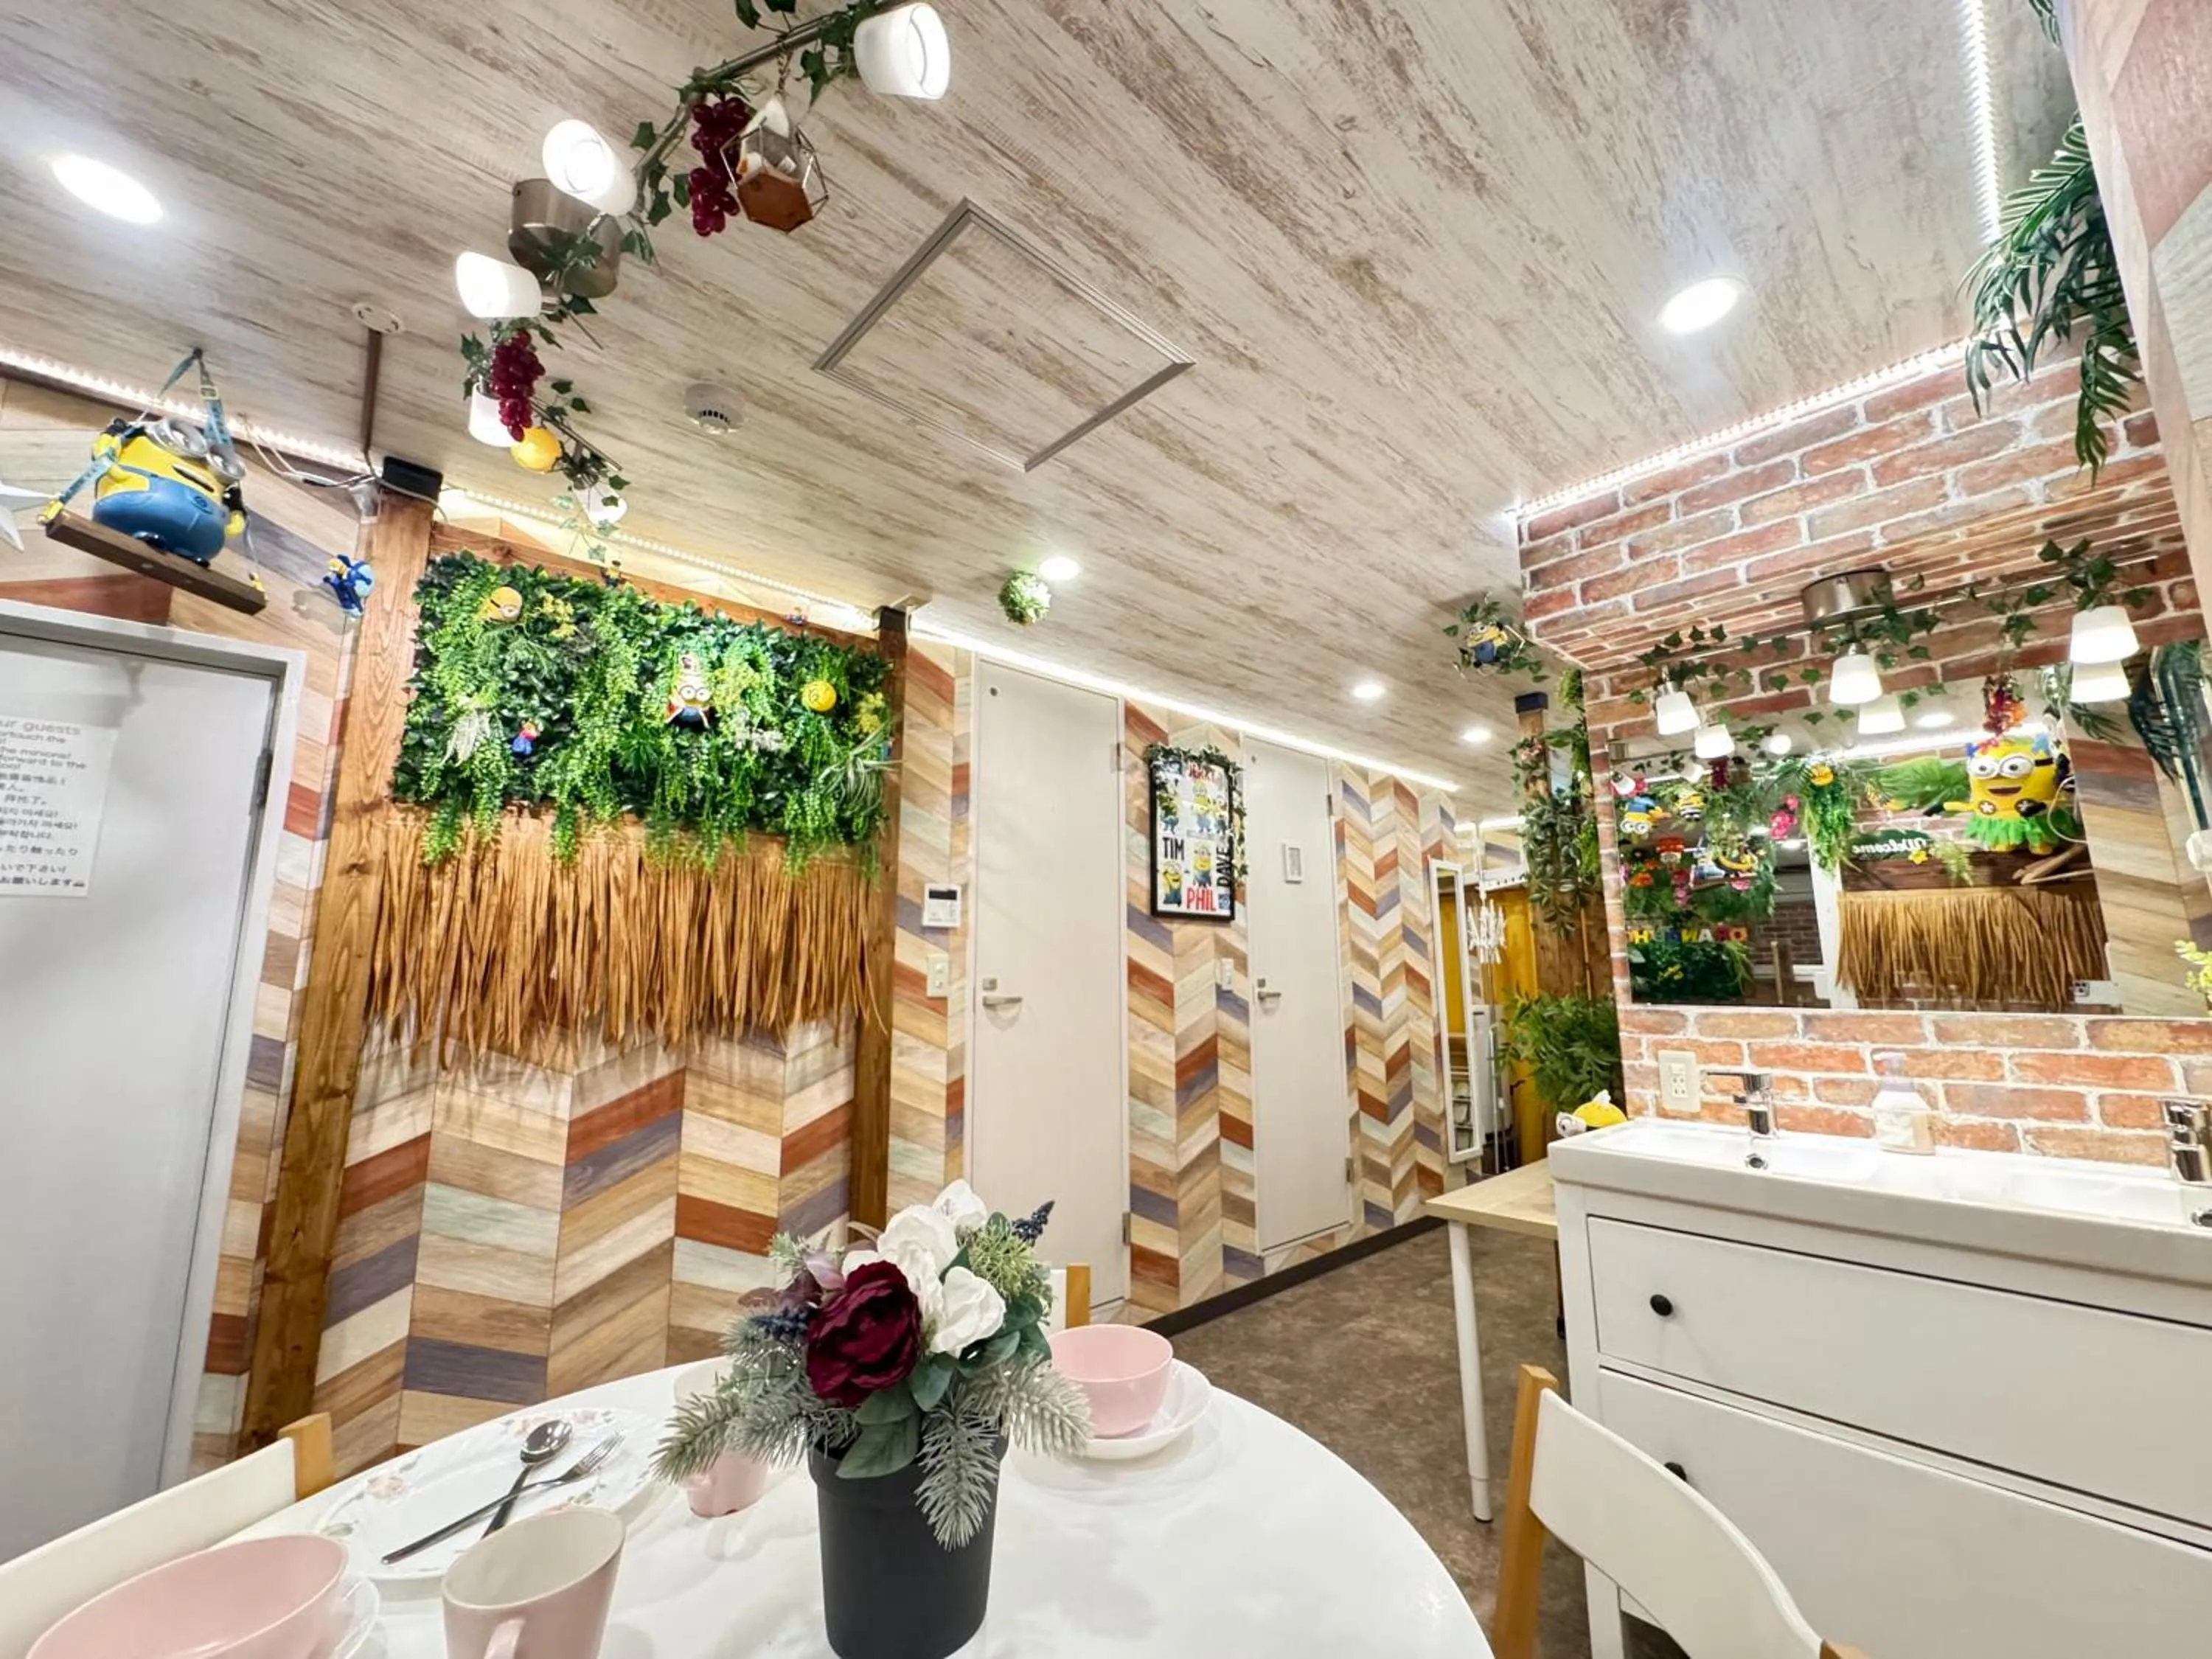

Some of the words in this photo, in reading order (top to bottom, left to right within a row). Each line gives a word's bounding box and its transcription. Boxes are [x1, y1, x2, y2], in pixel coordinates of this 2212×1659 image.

[23, 722, 80, 735] guests
[1163, 837, 1185, 861] TIM
[1216, 846, 1232, 888] DAVE
[1186, 887, 1217, 911] PHIL
